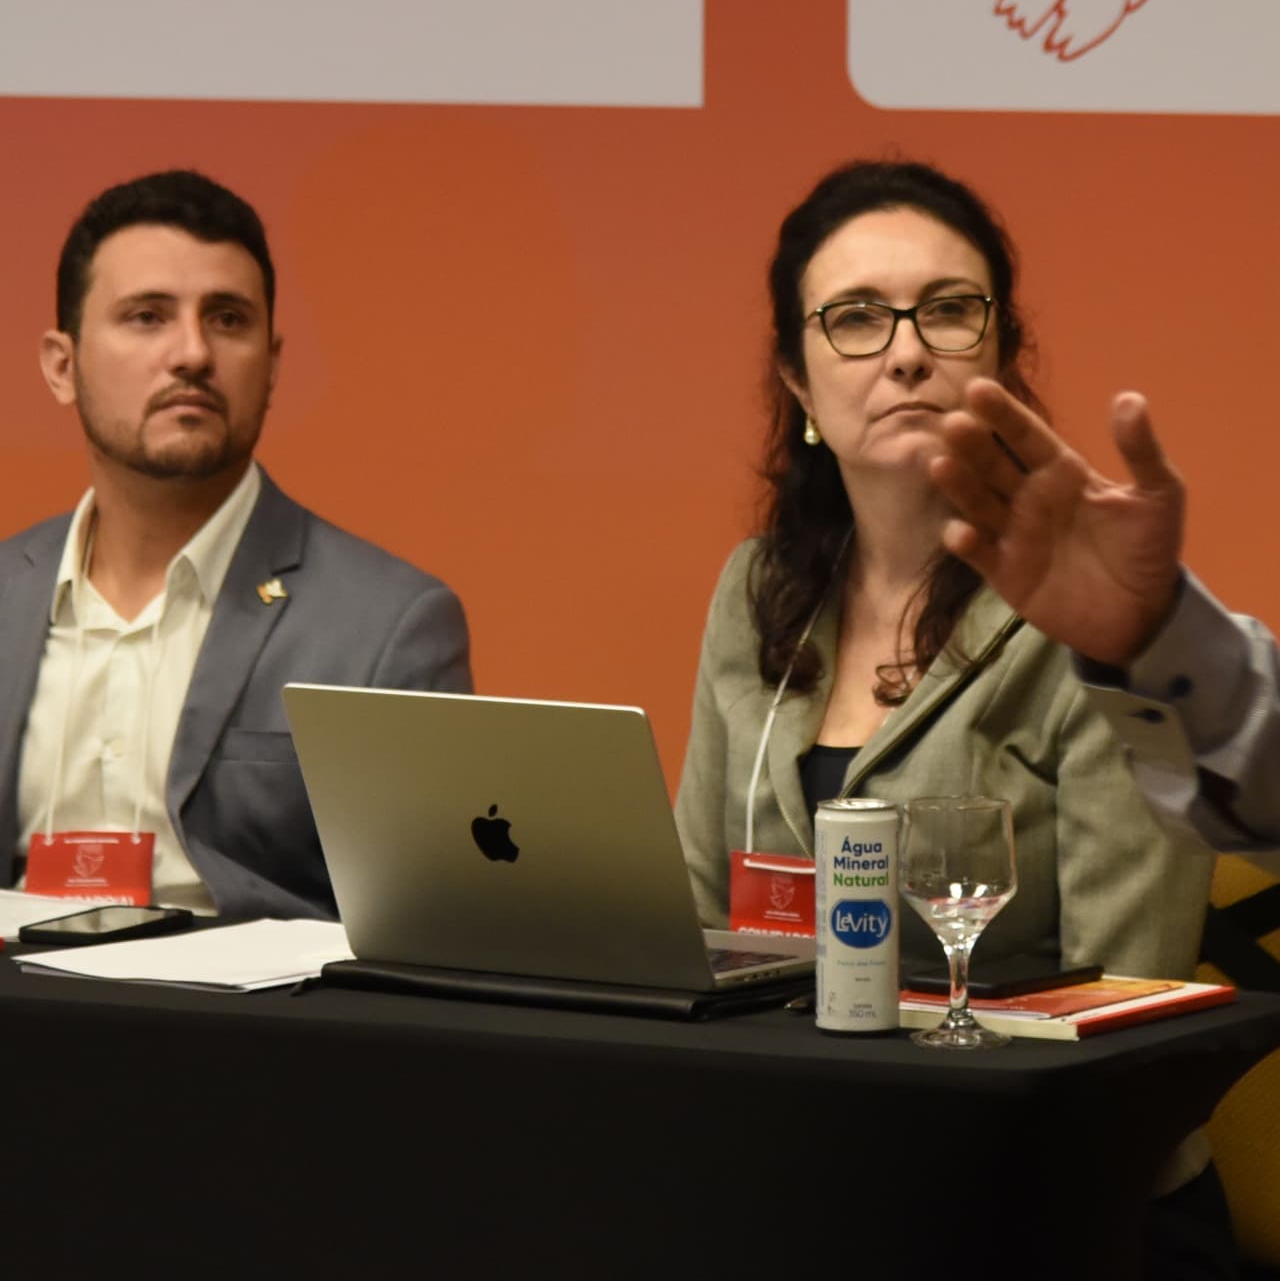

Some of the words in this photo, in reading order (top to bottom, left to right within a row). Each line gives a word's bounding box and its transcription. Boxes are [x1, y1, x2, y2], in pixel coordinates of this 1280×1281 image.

[841, 835, 882, 856] Água
[834, 856, 889, 870] Mineral
[833, 873, 889, 887] Natural
